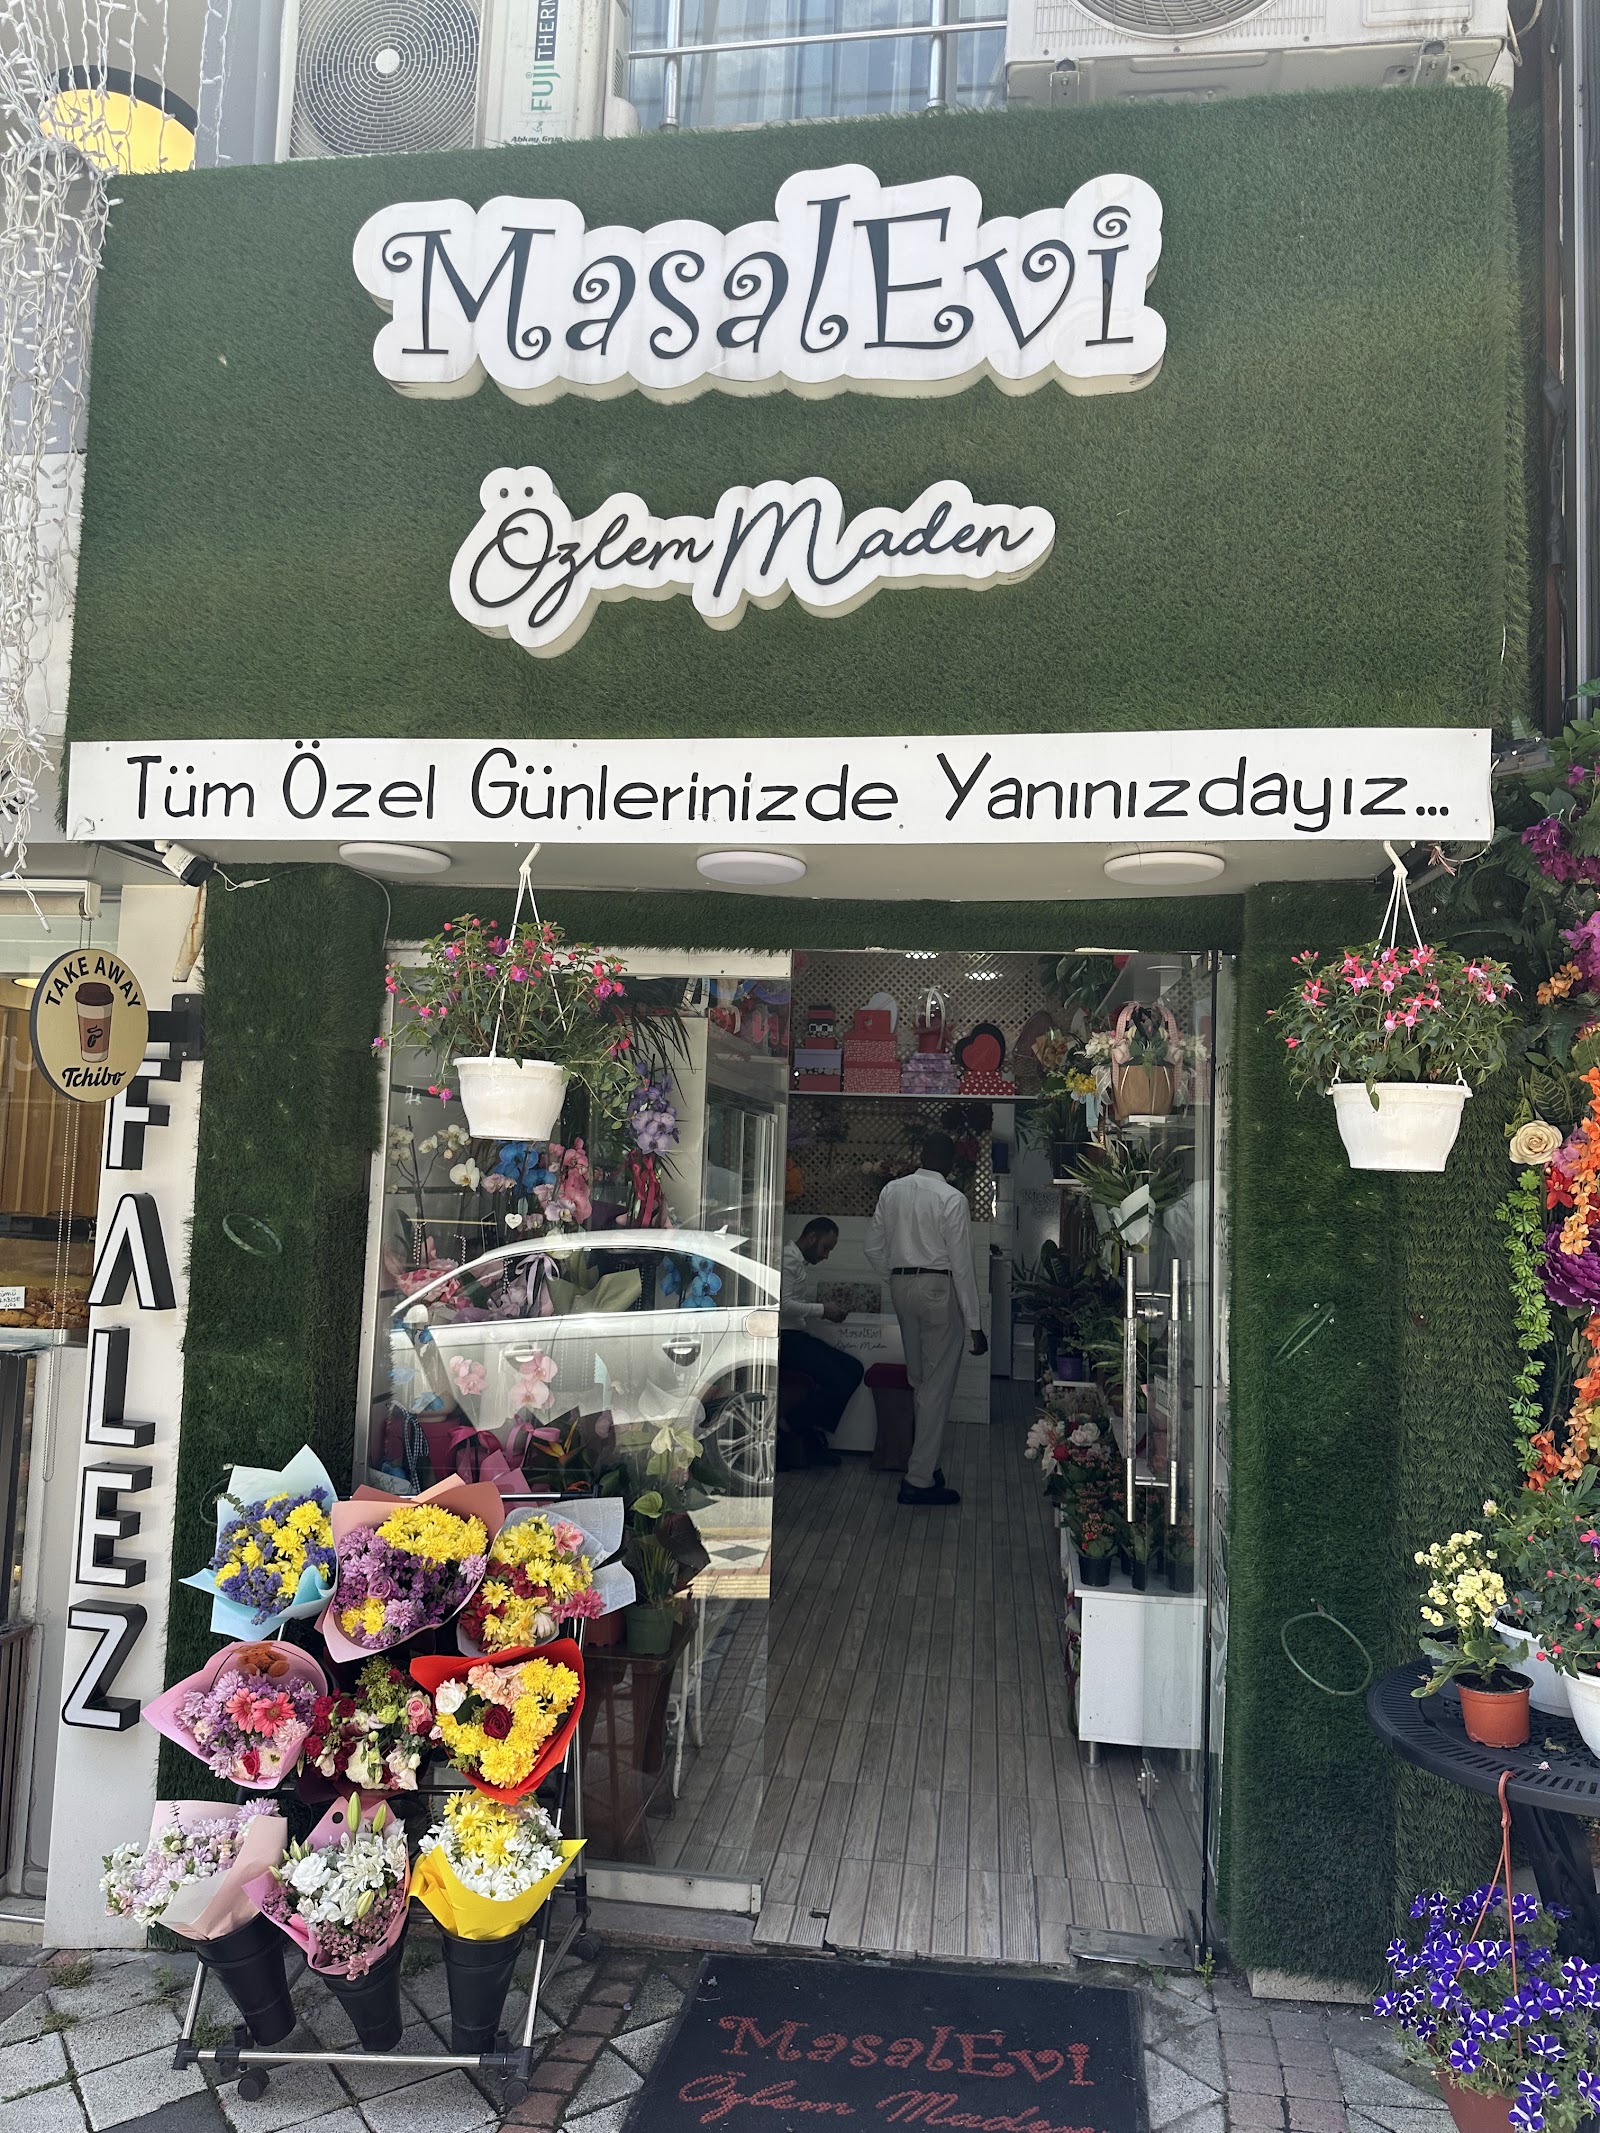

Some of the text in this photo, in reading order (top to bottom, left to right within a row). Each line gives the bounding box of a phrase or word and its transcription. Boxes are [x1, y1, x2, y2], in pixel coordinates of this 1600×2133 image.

[382, 195, 1134, 361] MasalEvi
[469, 487, 1034, 628] Özlem Maden
[127, 741, 1450, 832] Tüm Özel Günlerinizde Yanınızdayız...
[45, 956, 141, 1008] TAKE AWAY
[62, 1066, 127, 1088] Tchibo
[718, 2015, 1095, 2087] MasalEvi
[679, 2071, 855, 2124] Özlem
